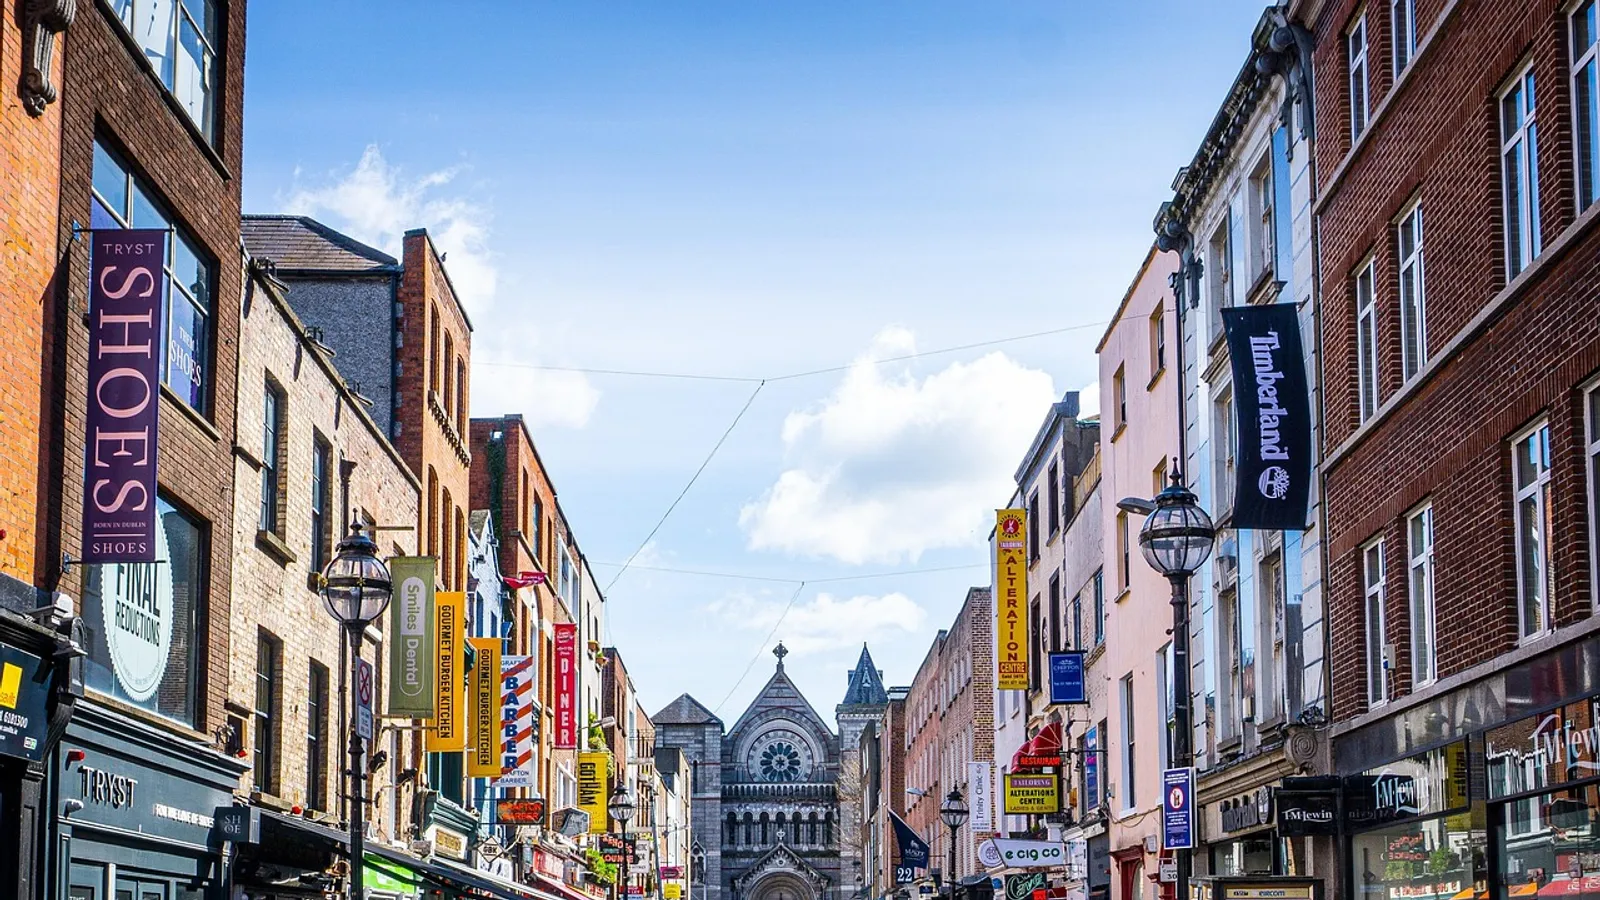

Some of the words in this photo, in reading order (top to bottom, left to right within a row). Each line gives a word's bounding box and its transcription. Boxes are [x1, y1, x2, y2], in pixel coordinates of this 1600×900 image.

[103, 243, 155, 255] TRYST
[171, 340, 202, 387] SHOES
[92, 265, 155, 513] SHOES
[1249, 331, 1290, 461] Timberland
[92, 542, 147, 554] SHOES
[117, 563, 160, 618] FINAL
[407, 584, 420, 630] Smiles
[1006, 555, 1018, 661] ALTERATION
[115, 600, 160, 647] REDUCTIONS
[441, 605, 451, 646] GOURMET
[406, 638, 419, 686] Dental
[441, 650, 451, 692] BURGER
[480, 648, 490, 690] GOURMET
[1001, 663, 1025, 673] CENTRE
[440, 700, 450, 739] KITCHEN
[480, 692, 490, 723] BURGER
[560, 658, 570, 744] DINER
[504, 676, 520, 769] BARBER
[480, 724, 490, 766] KITCHEN
[1020, 756, 1060, 765] RESTAURANT
[82, 765, 138, 808] TRYST
[579, 762, 602, 806] GOTHAM
[975, 776, 984, 795] Clinic
[1010, 789, 1055, 797] ALTERATIONS
[975, 796, 985, 819] Trinity
[897, 867, 913, 882] 22
[1005, 850, 1013, 859] e
[1017, 849, 1038, 861] cig
[1042, 848, 1060, 858] co
